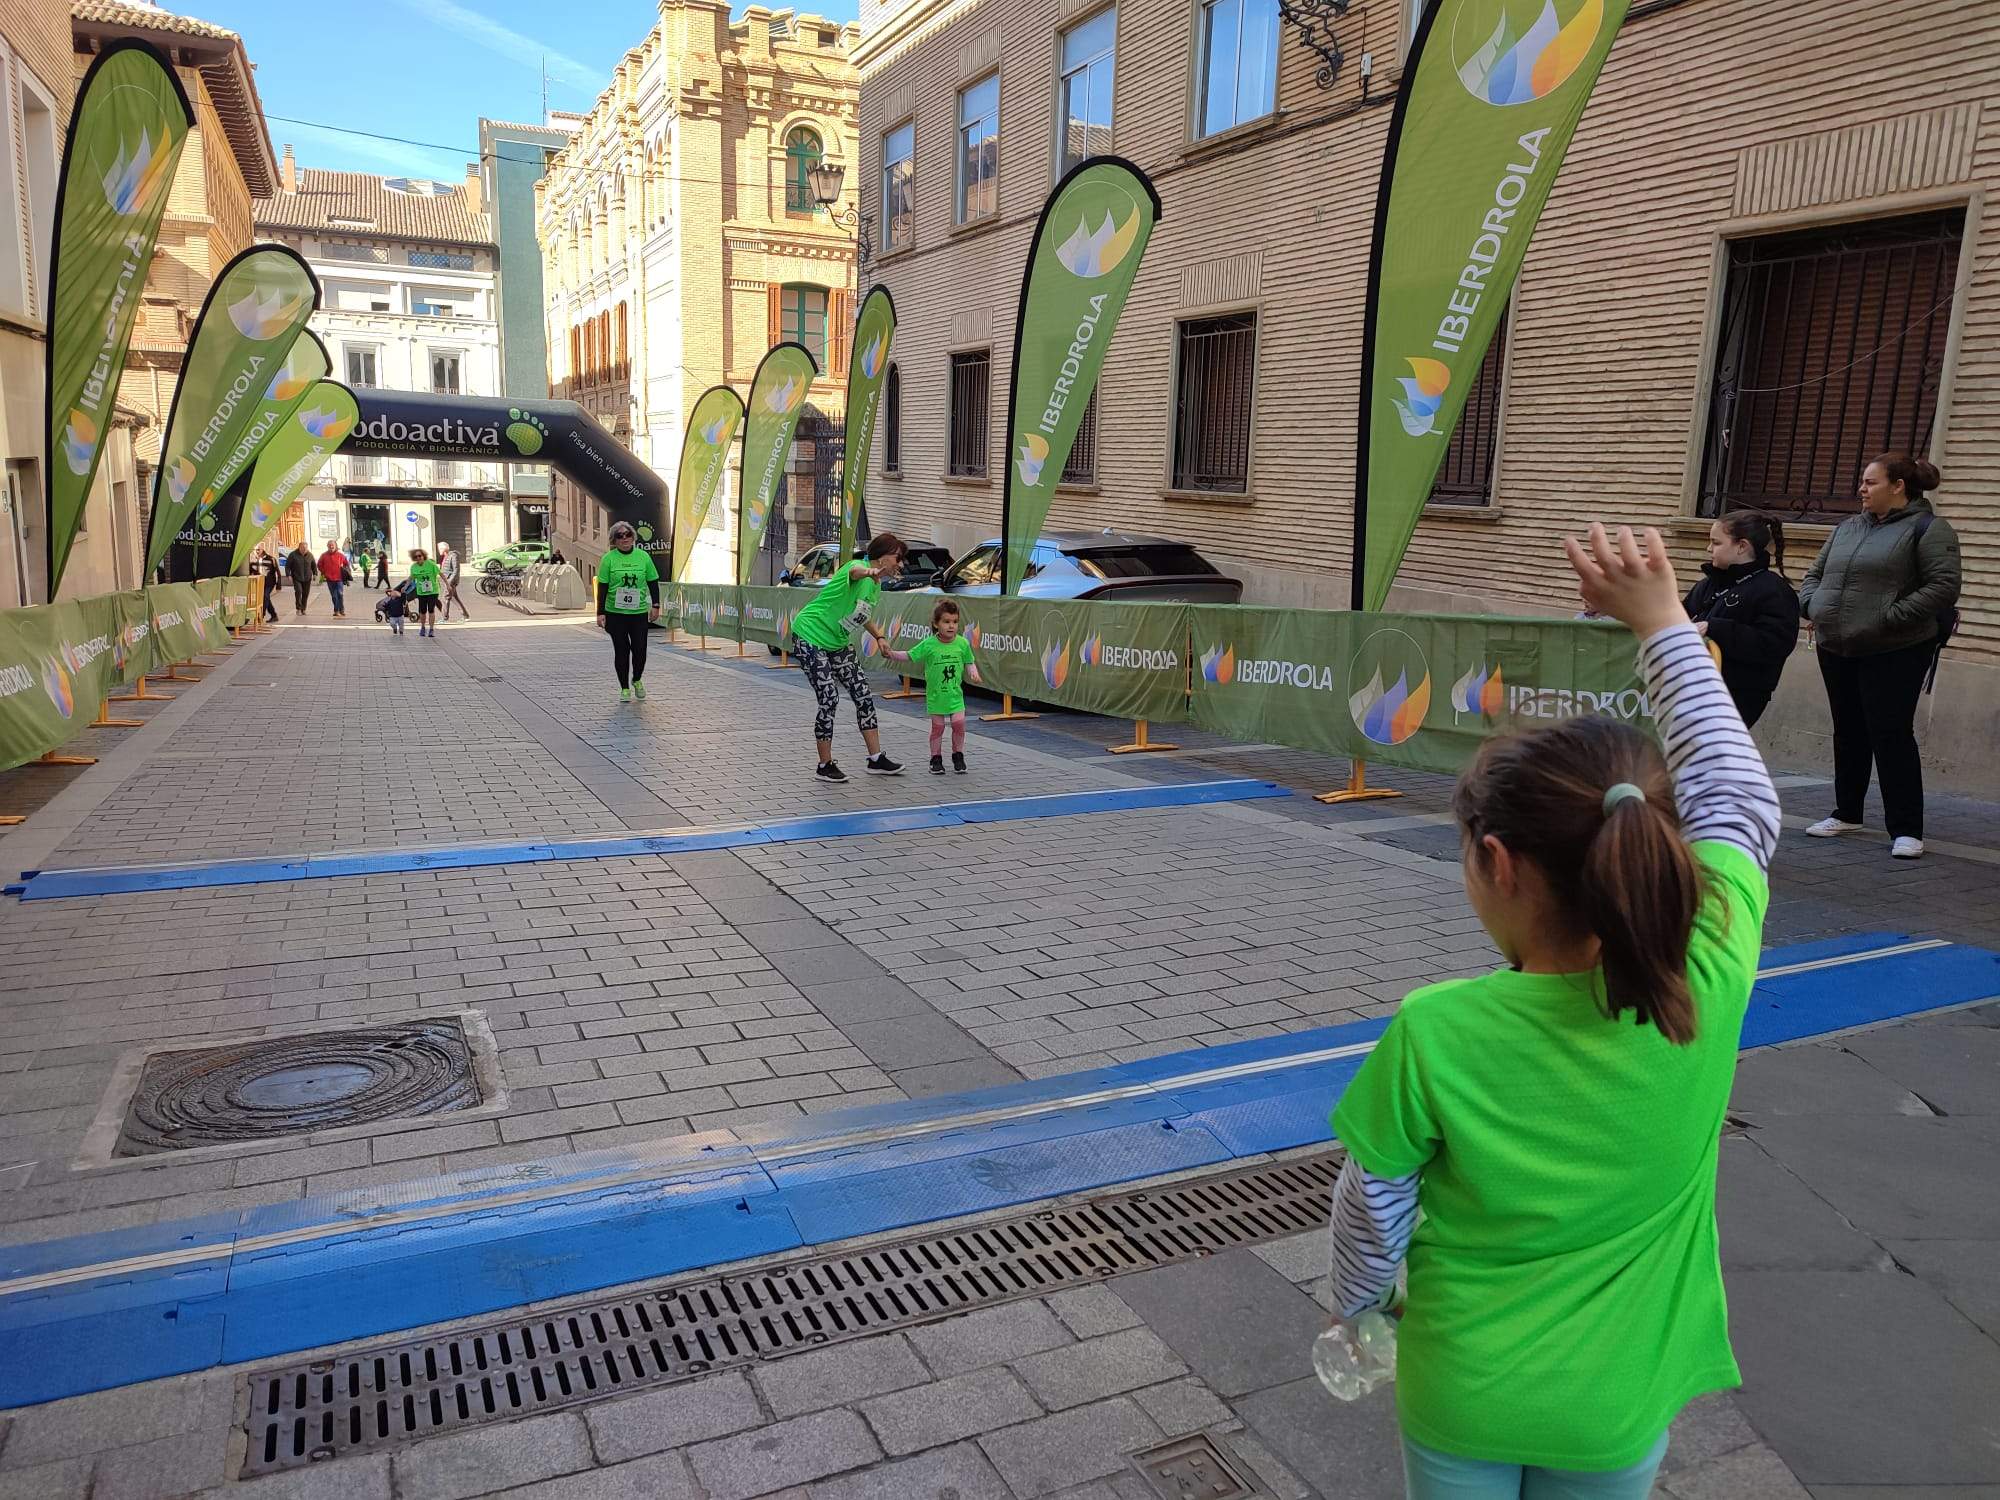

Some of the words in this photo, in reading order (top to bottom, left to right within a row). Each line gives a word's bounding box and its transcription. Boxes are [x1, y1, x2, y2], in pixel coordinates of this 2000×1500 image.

[1432, 127, 1552, 353] IBERDROLA
[1039, 293, 1108, 434] IBERDROLA
[190, 355, 265, 462] IBERDROLA
[350, 414, 499, 446] odoactiva
[355, 440, 416, 451] PODOLOGÍA
[211, 411, 280, 489] IBERDROLA
[569, 430, 587, 450] Pisa
[586, 446, 604, 468] bien,
[605, 464, 621, 480] vive
[621, 477, 644, 501] mejor
[757, 420, 791, 499] IBERDROLA
[268, 445, 324, 505] IBERDROLA
[691, 452, 721, 516] IBERDROLA
[436, 492, 470, 502] INSIDE
[623, 595, 633, 603] 43
[900, 622, 933, 640] IBERDR
[980, 633, 1033, 654] IBERDROLA
[1101, 645, 1178, 670] IBERDROLA
[1237, 659, 1333, 691] IBERDROLA
[1510, 685, 1657, 719] IBERDROL
